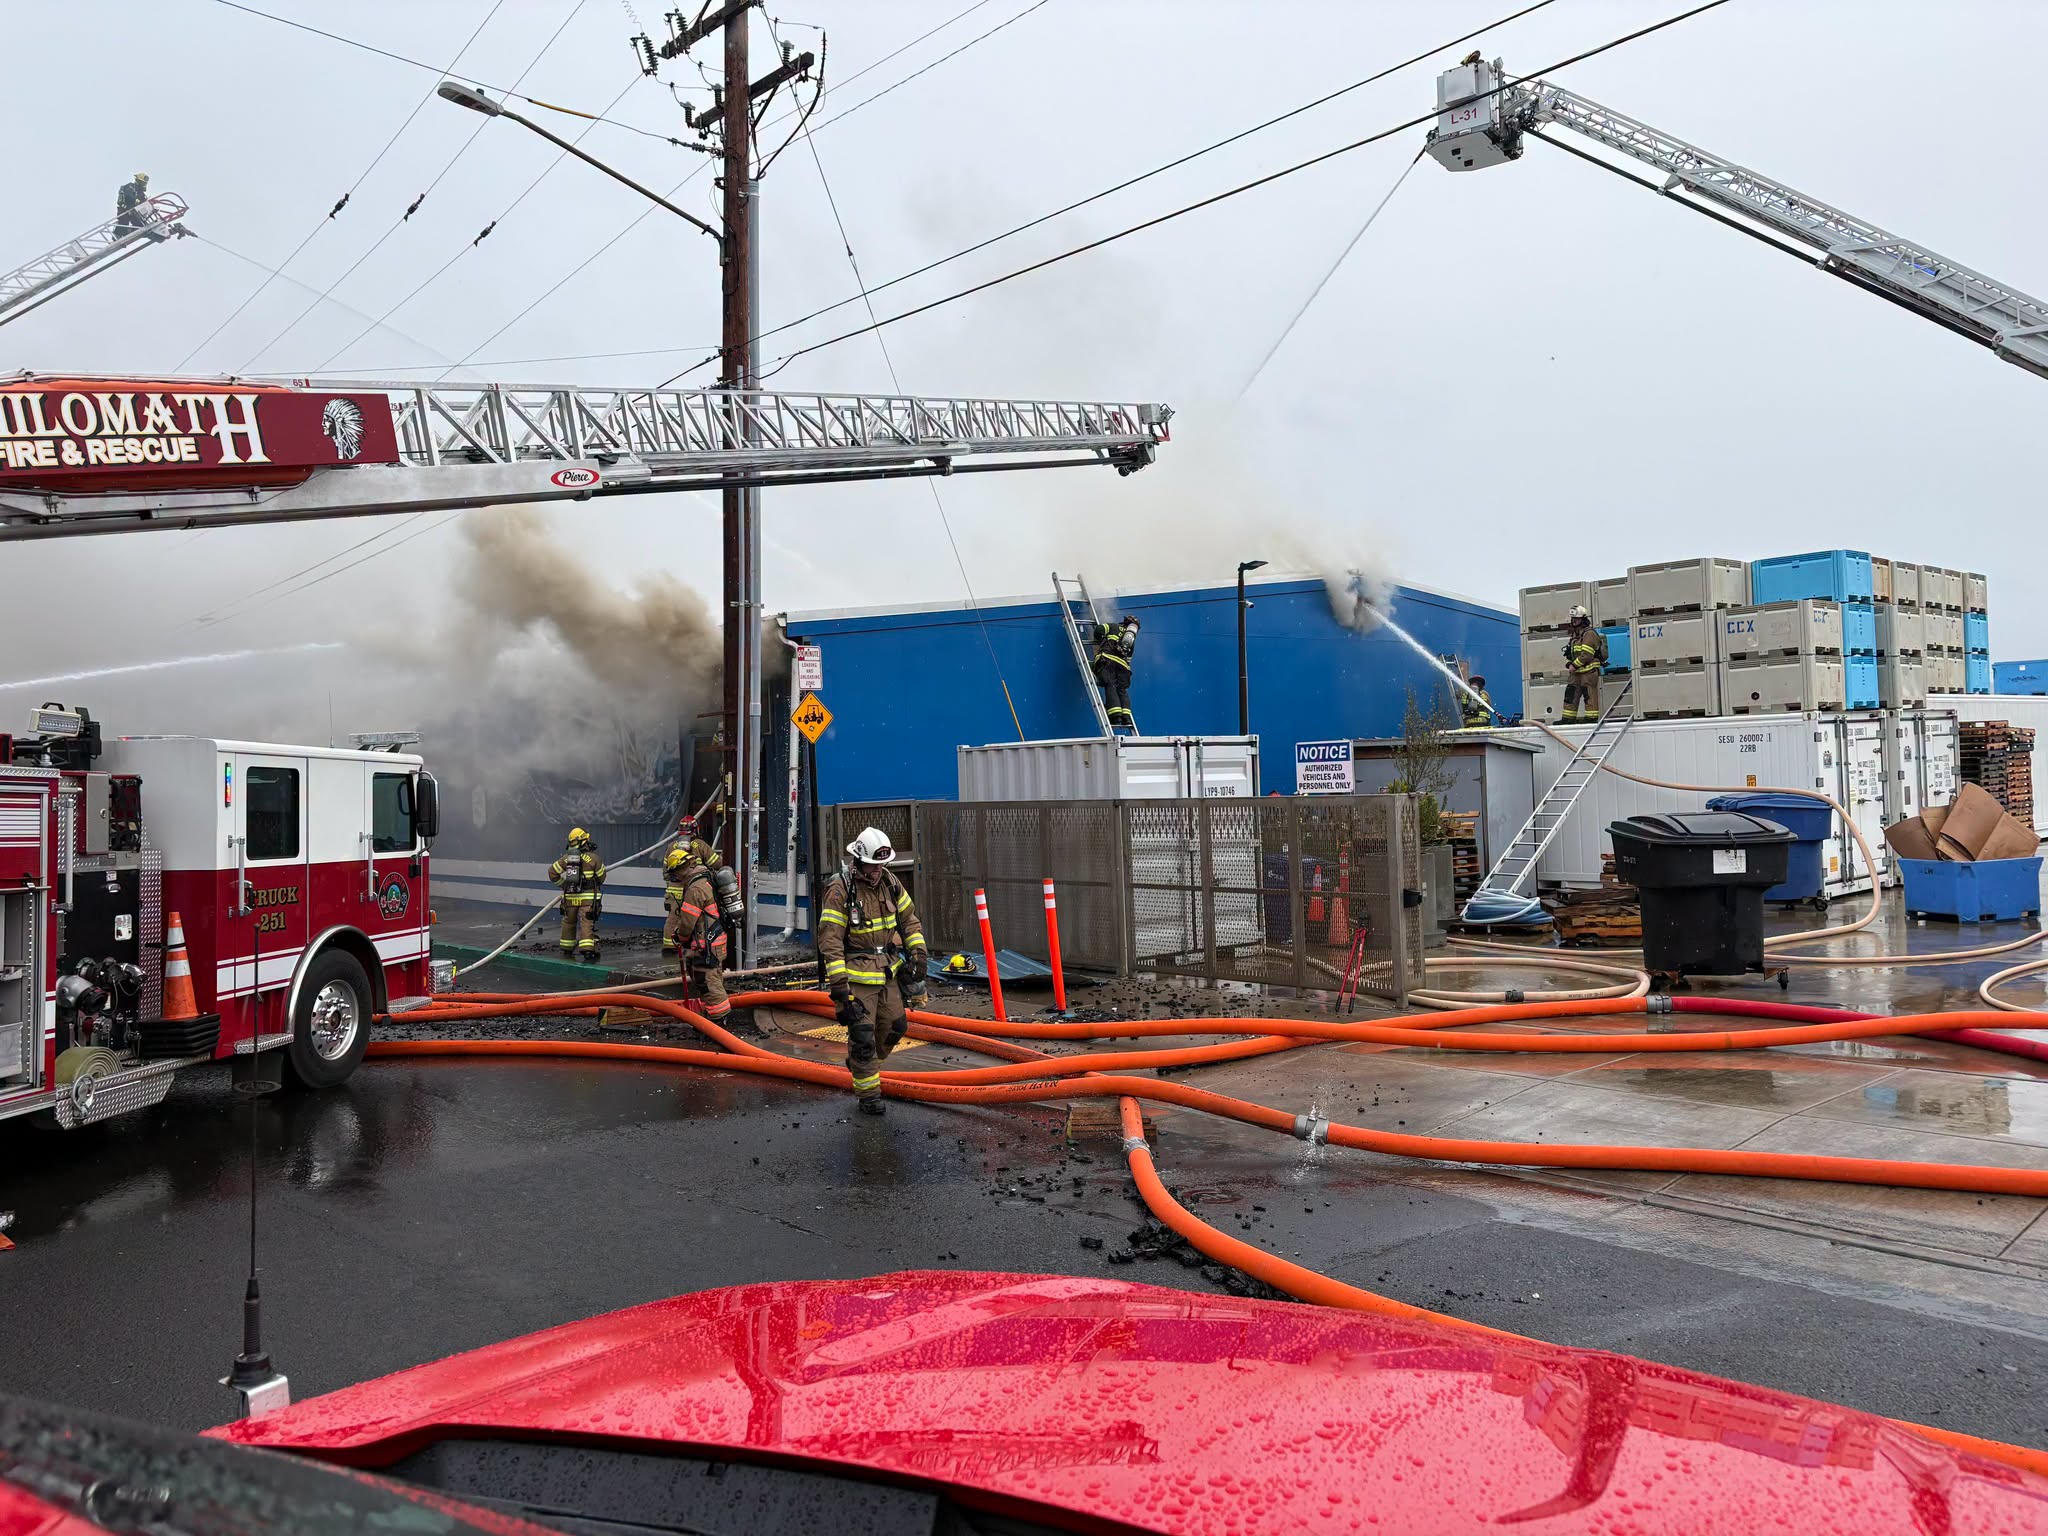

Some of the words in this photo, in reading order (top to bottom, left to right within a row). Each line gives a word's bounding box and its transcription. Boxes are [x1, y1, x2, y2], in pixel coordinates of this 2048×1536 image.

[1450, 107, 1478, 125] L-31
[292, 378, 304, 387] 65
[61, 439, 85, 465] &
[85, 437, 200, 465] RESCUE
[562, 471, 590, 484] Pierce
[1639, 626, 1664, 638] CCX
[1727, 620, 1755, 634] CCX
[1718, 735, 1735, 743] SESU
[1740, 733, 1764, 743] 260002
[1299, 745, 1347, 760] NOTICE
[1304, 763, 1343, 772] AUTHORIZED
[1303, 773, 1332, 781] VEHICLES
[1332, 772, 1346, 780] AND
[1299, 782, 1335, 790] PERSONNEL
[1335, 781, 1351, 789] ONLY
[260, 911, 286, 931] 251
